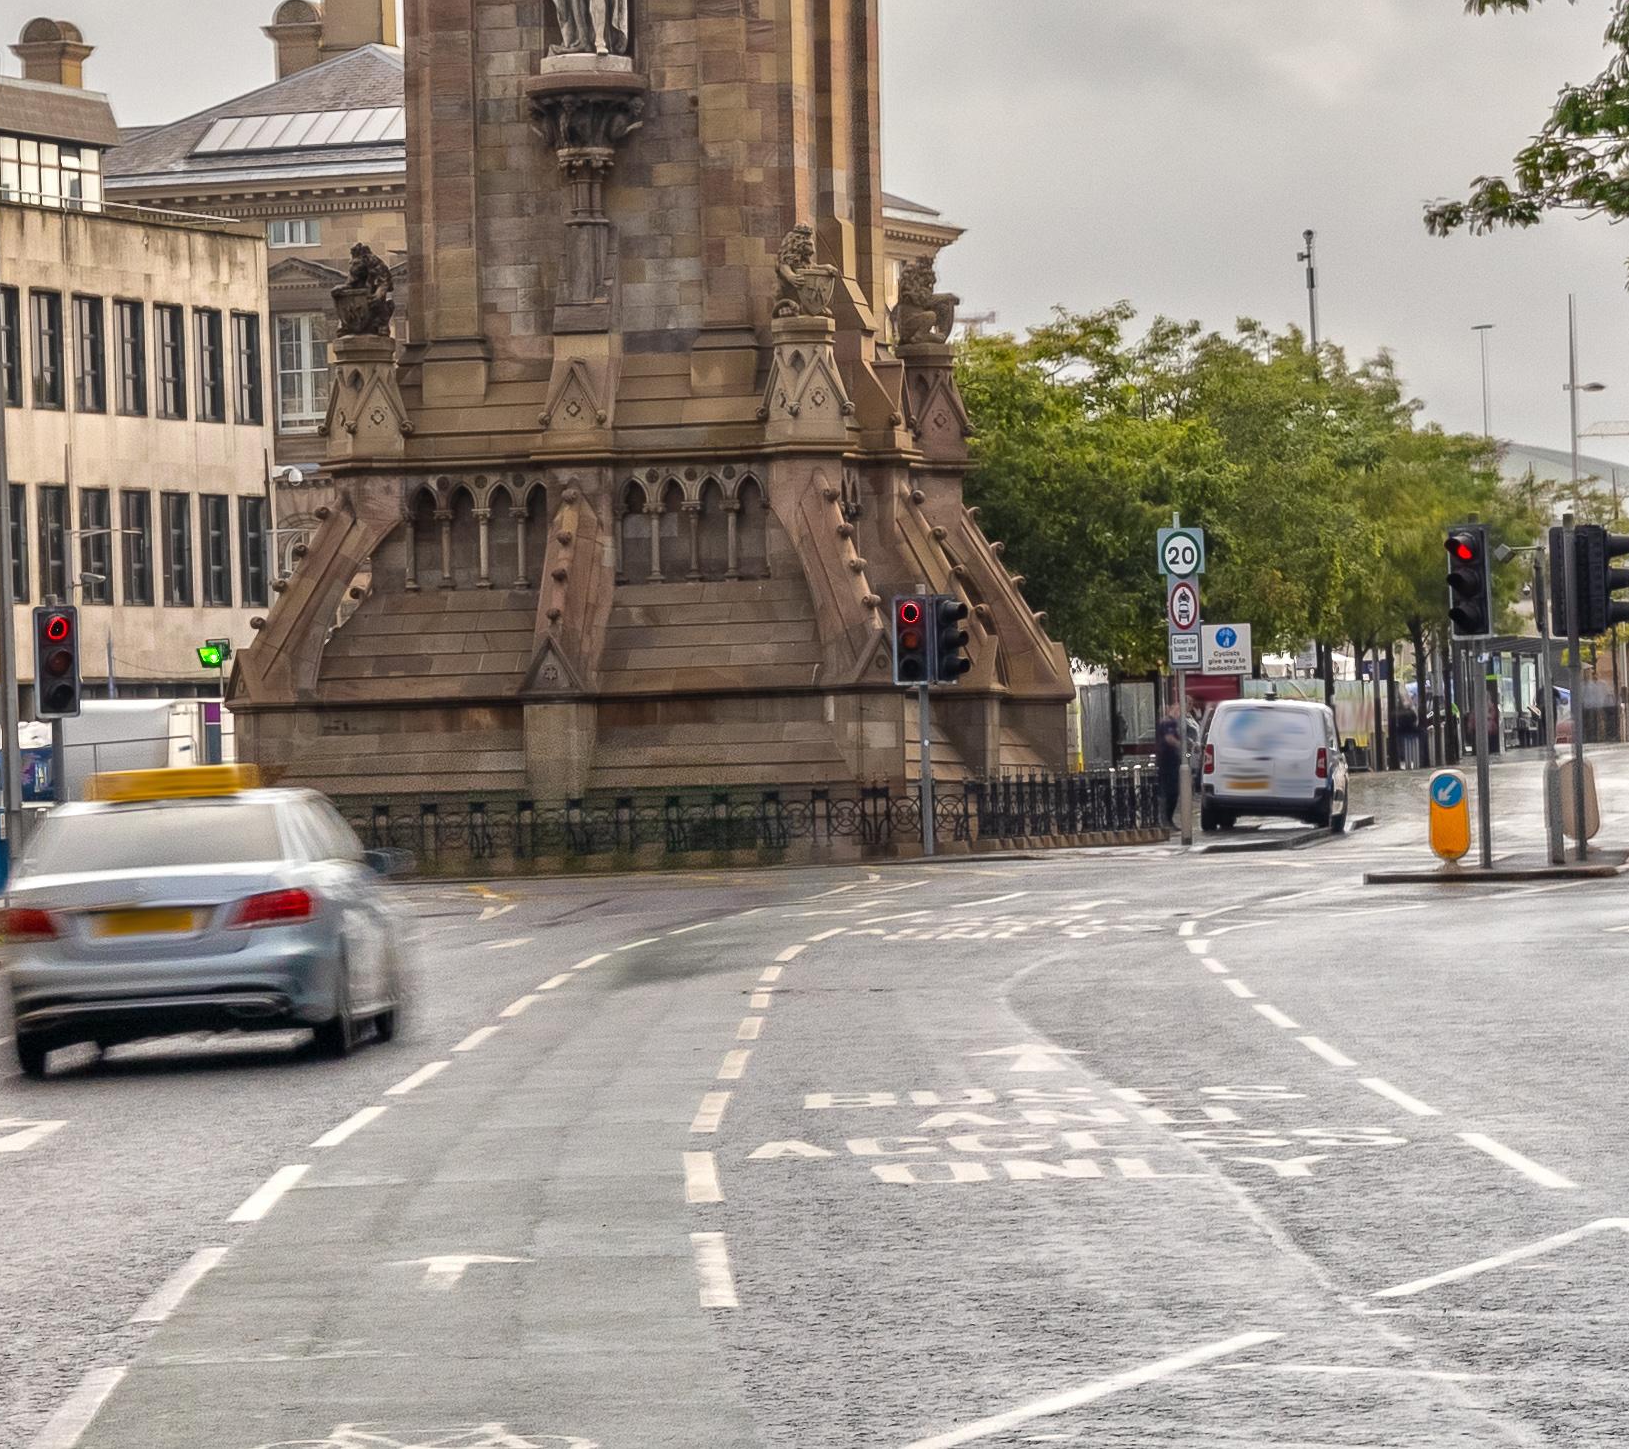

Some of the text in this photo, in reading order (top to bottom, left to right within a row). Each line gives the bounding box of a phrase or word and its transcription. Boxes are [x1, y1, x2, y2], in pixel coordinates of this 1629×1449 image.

[1167, 546, 1195, 565] 20
[1173, 637, 1188, 645] Except
[803, 1086, 1307, 1110] BUSES
[917, 1107, 1244, 1129] AND
[747, 1127, 1408, 1159] ACCESS
[871, 1155, 1330, 1184] ONLY
